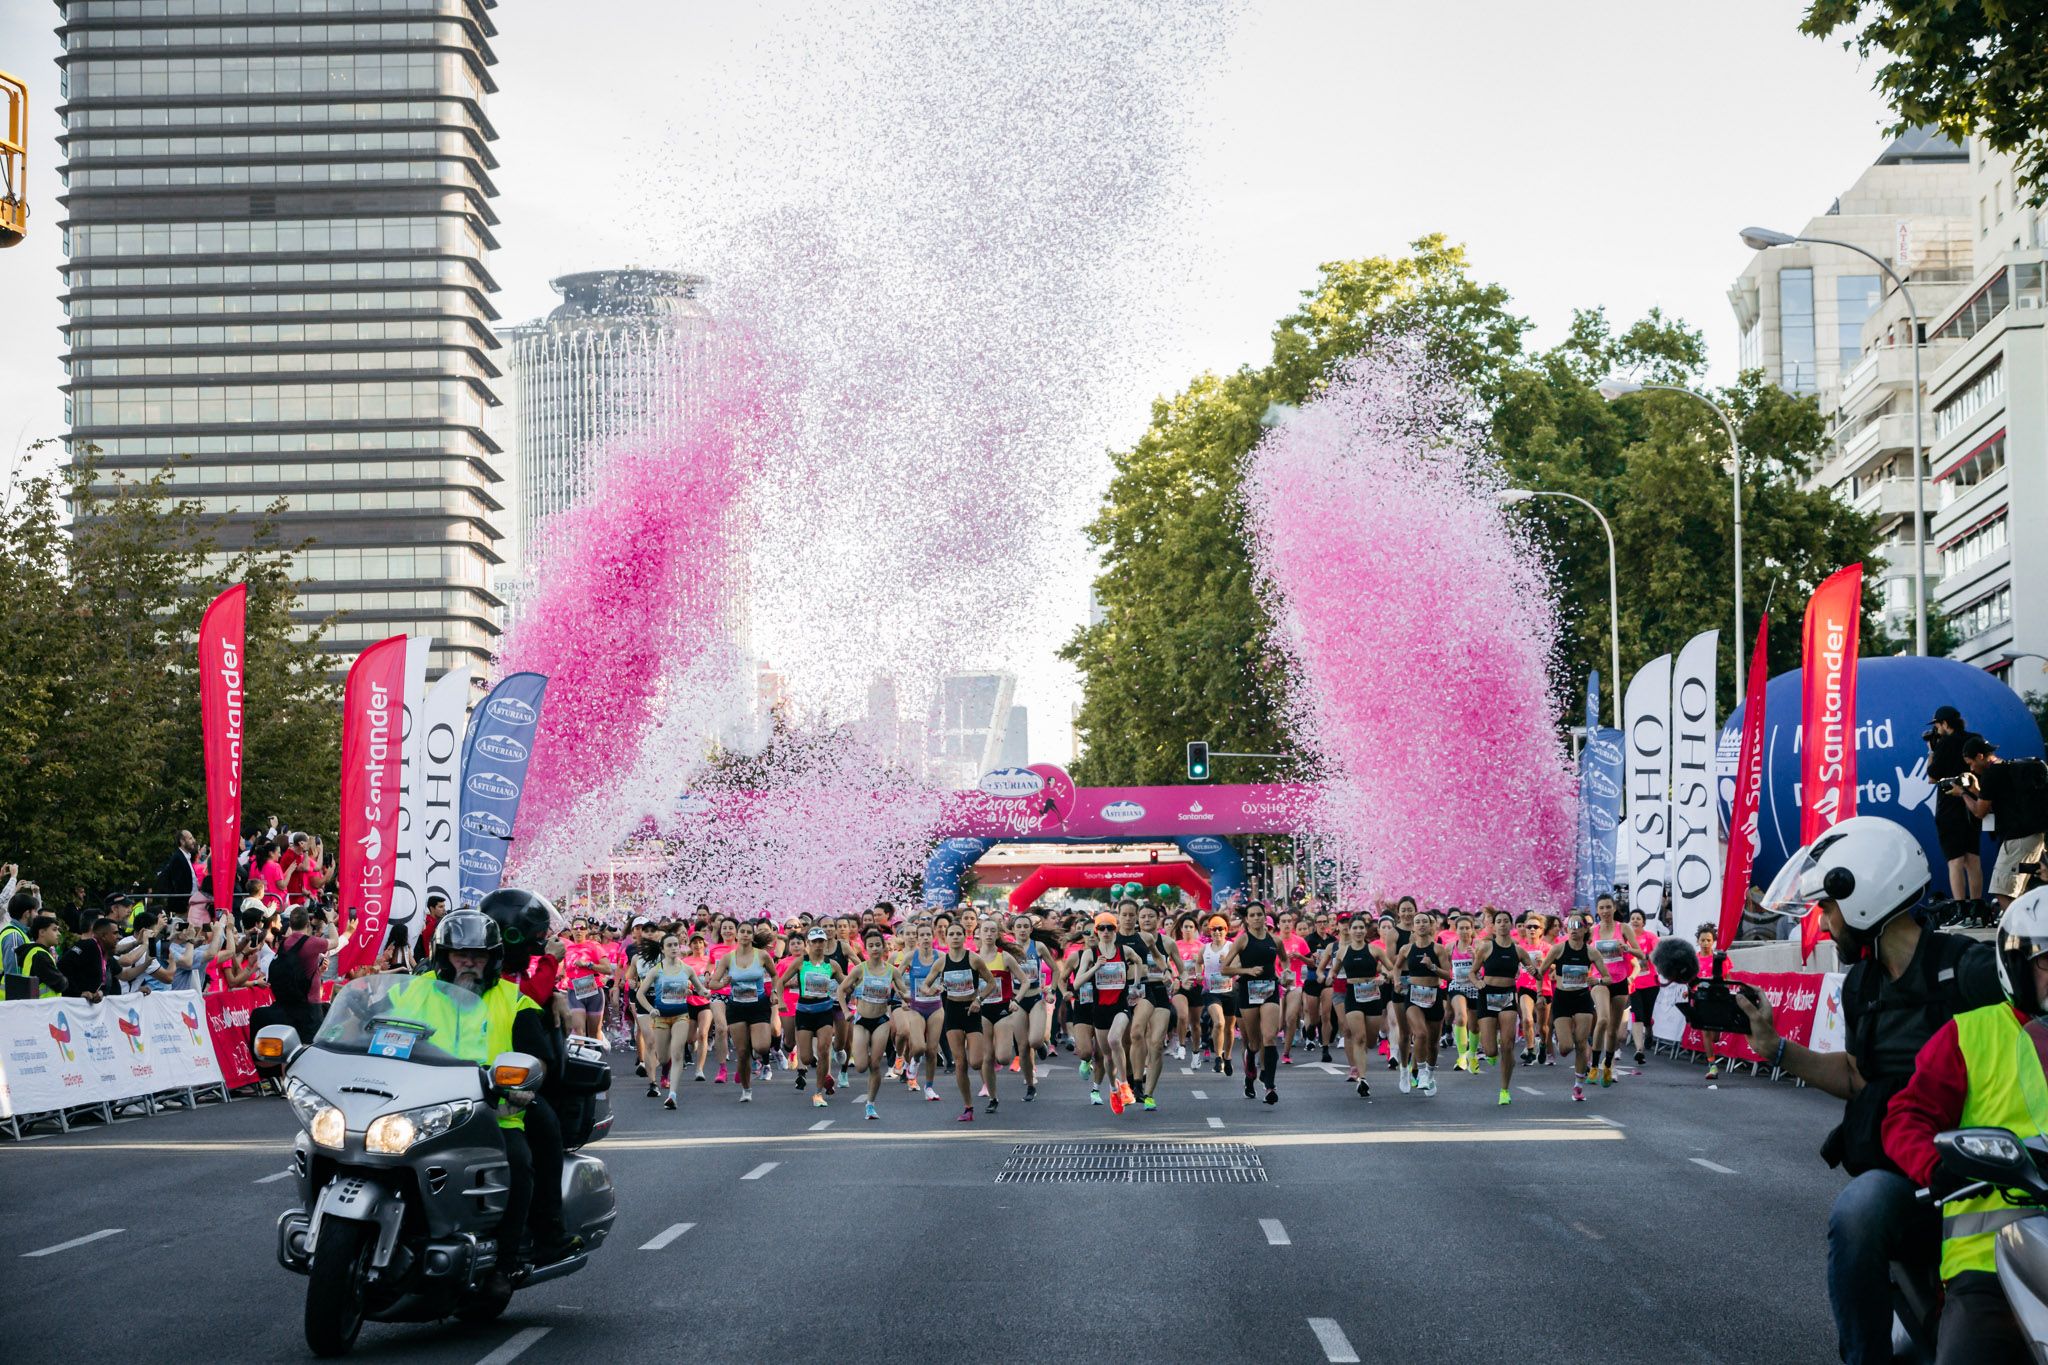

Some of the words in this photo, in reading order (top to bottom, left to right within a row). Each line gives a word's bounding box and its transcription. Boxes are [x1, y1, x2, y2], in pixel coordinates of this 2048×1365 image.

[490, 703, 532, 722] ASTURIANA
[1819, 619, 1843, 783] Santander
[365, 681, 388, 823] Santander
[480, 741, 523, 759] ASTURIANA
[470, 778, 514, 797] ASTURIANA
[1677, 677, 1712, 900] OYSHO
[1004, 808, 1048, 836] Mujer
[1178, 813, 1215, 821] Santander
[360, 864, 383, 949] Sports
